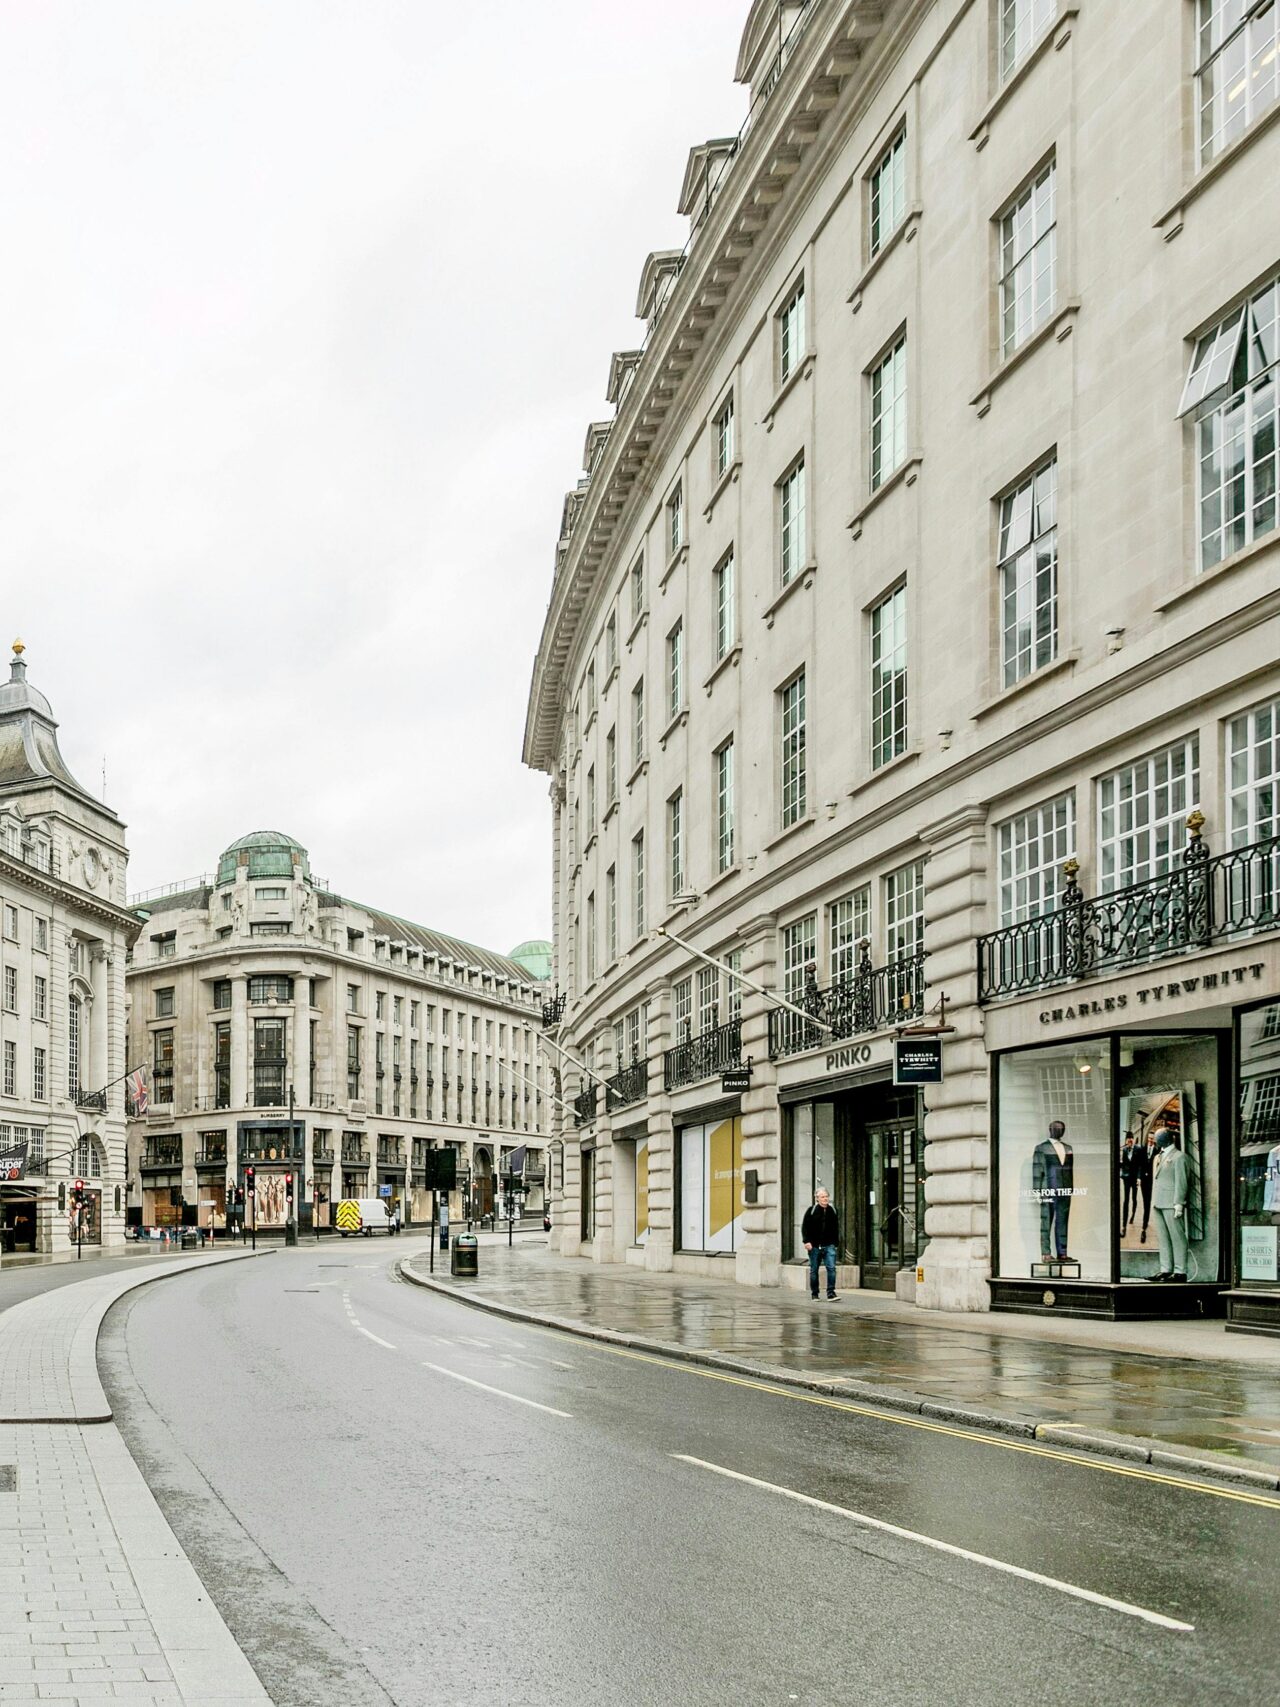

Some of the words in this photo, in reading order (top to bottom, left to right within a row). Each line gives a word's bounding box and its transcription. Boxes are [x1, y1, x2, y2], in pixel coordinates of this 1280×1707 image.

[1039, 994, 1128, 1024] CHARLES
[1136, 962, 1265, 1003] TYRWHITT
[826, 1045, 871, 1070] PINKO
[1041, 1188, 1056, 1196] FOR
[1056, 1188, 1073, 1196] THE
[1073, 1187, 1088, 1195] DAY
[1251, 1246, 1273, 1254] SHIRTS
